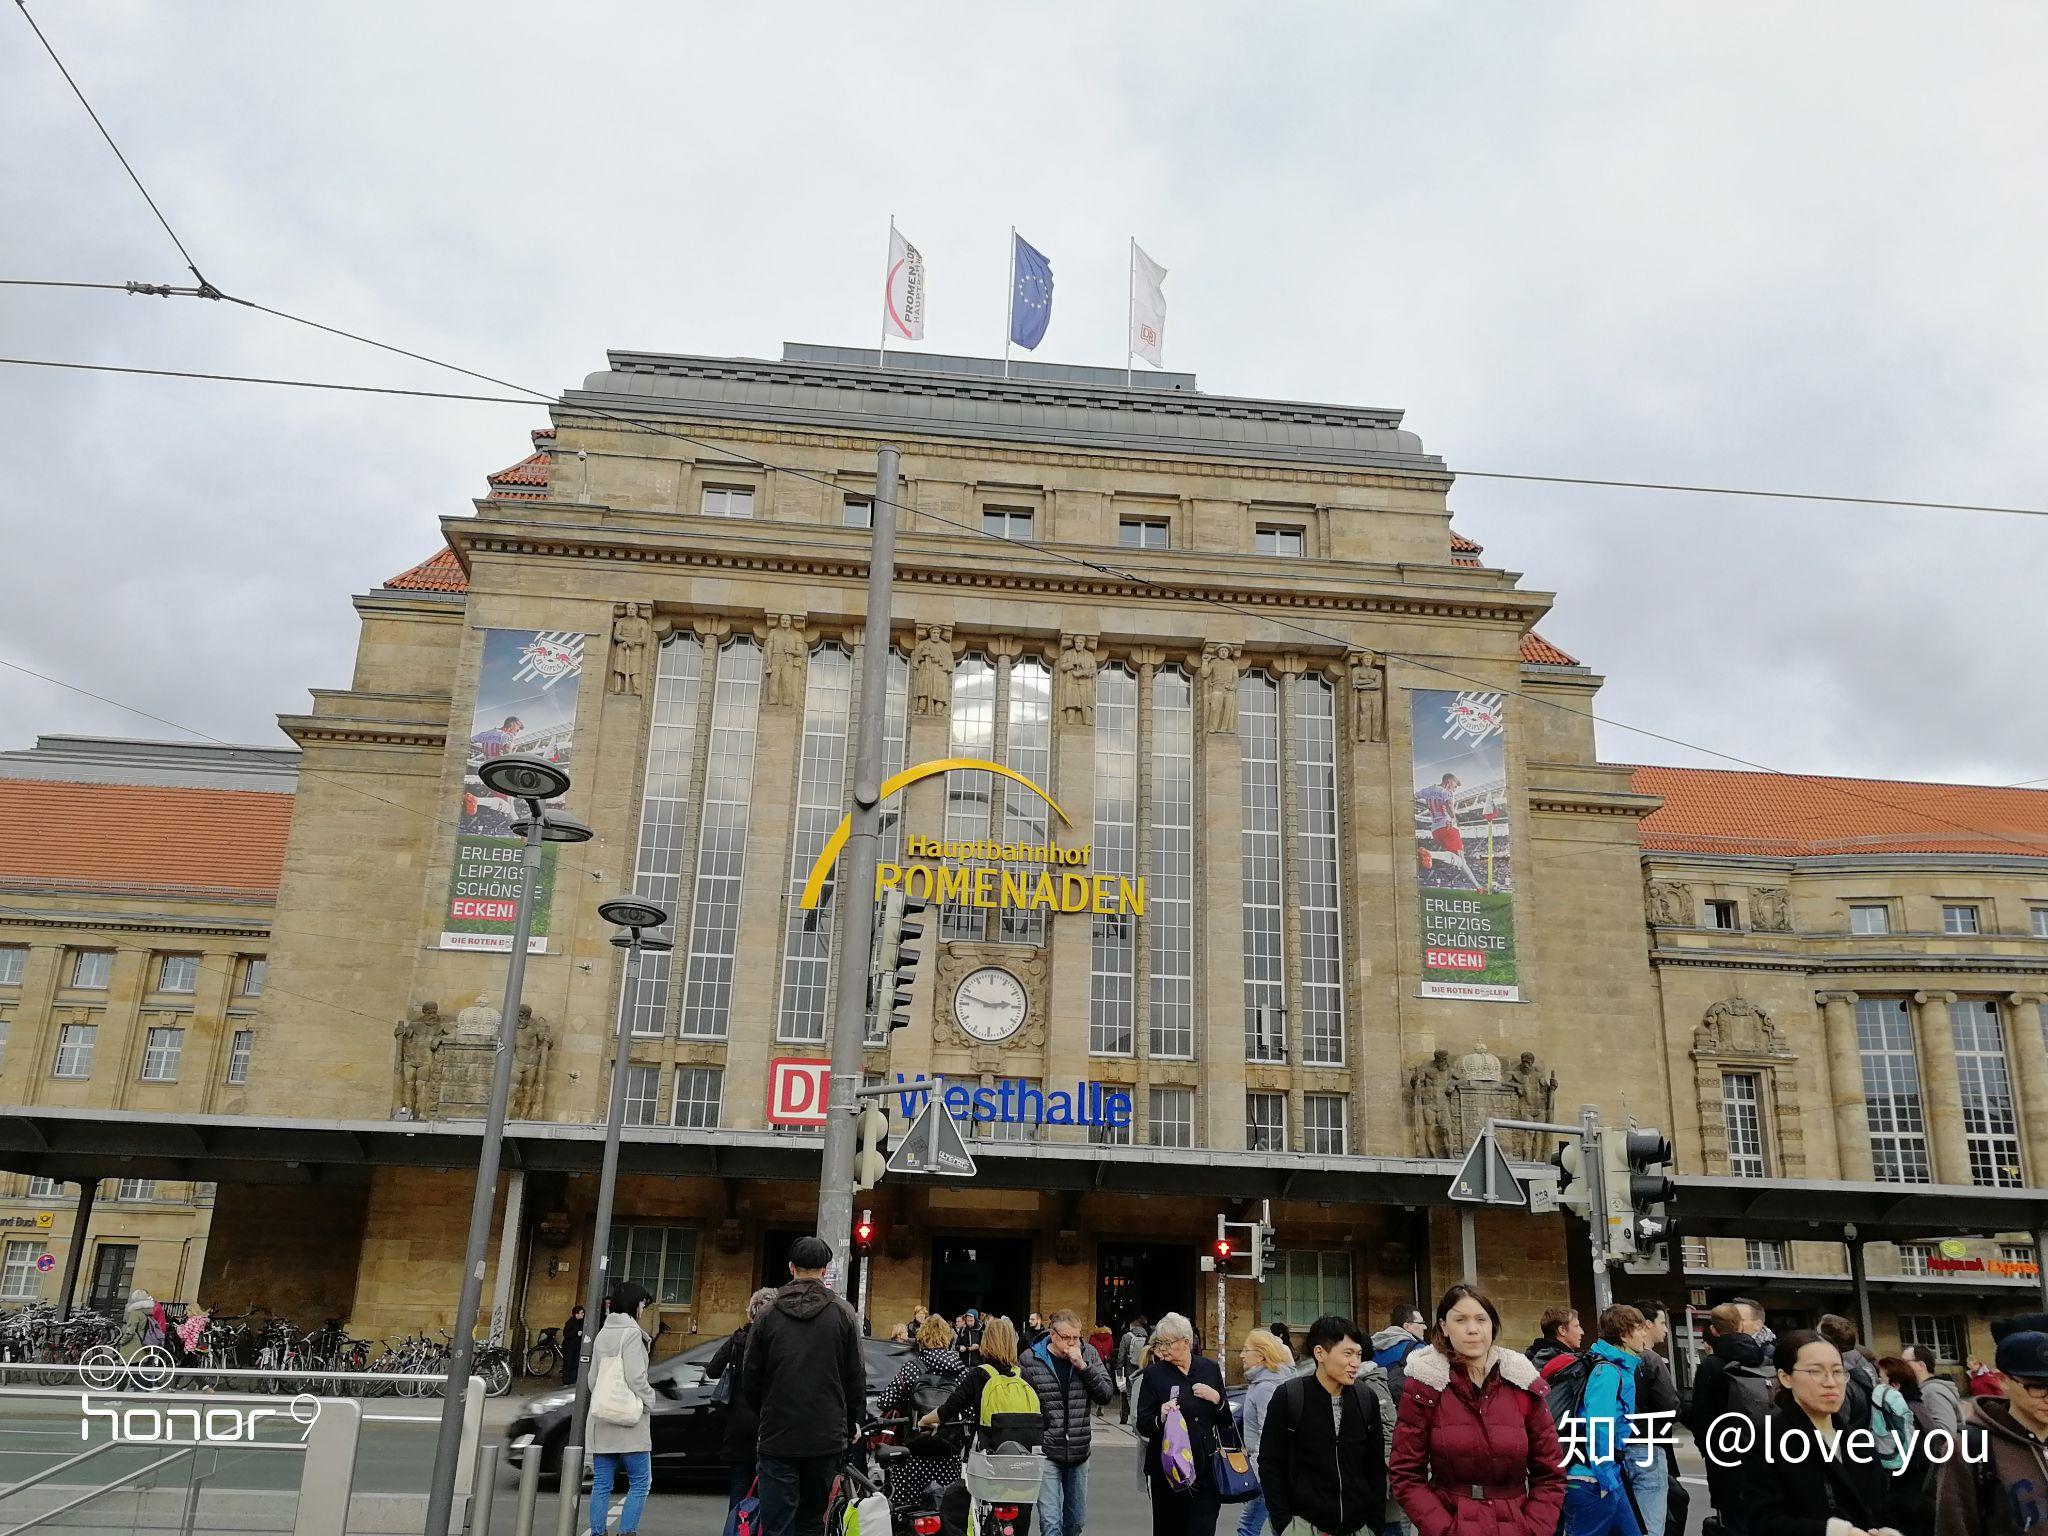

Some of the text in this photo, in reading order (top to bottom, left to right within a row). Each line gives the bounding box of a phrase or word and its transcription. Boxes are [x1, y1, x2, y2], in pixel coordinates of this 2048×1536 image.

[461, 846, 523, 862] ERLEBE
[908, 833, 1092, 865] Hauptbahnhof
[456, 881, 543, 899] SCHÖNSE
[875, 863, 1144, 917] ROMENADEN
[453, 902, 514, 918] ECKEN!
[1425, 899, 1481, 914] ERLEBE
[1426, 916, 1491, 931] LEIPZIGS
[468, 938, 497, 946] ROTEN
[1427, 932, 1506, 949] SCHÖNSTE
[1427, 952, 1483, 967] ECKEN!
[1446, 987, 1474, 995] ROTEN
[897, 1074, 1132, 1127] Westhalle
